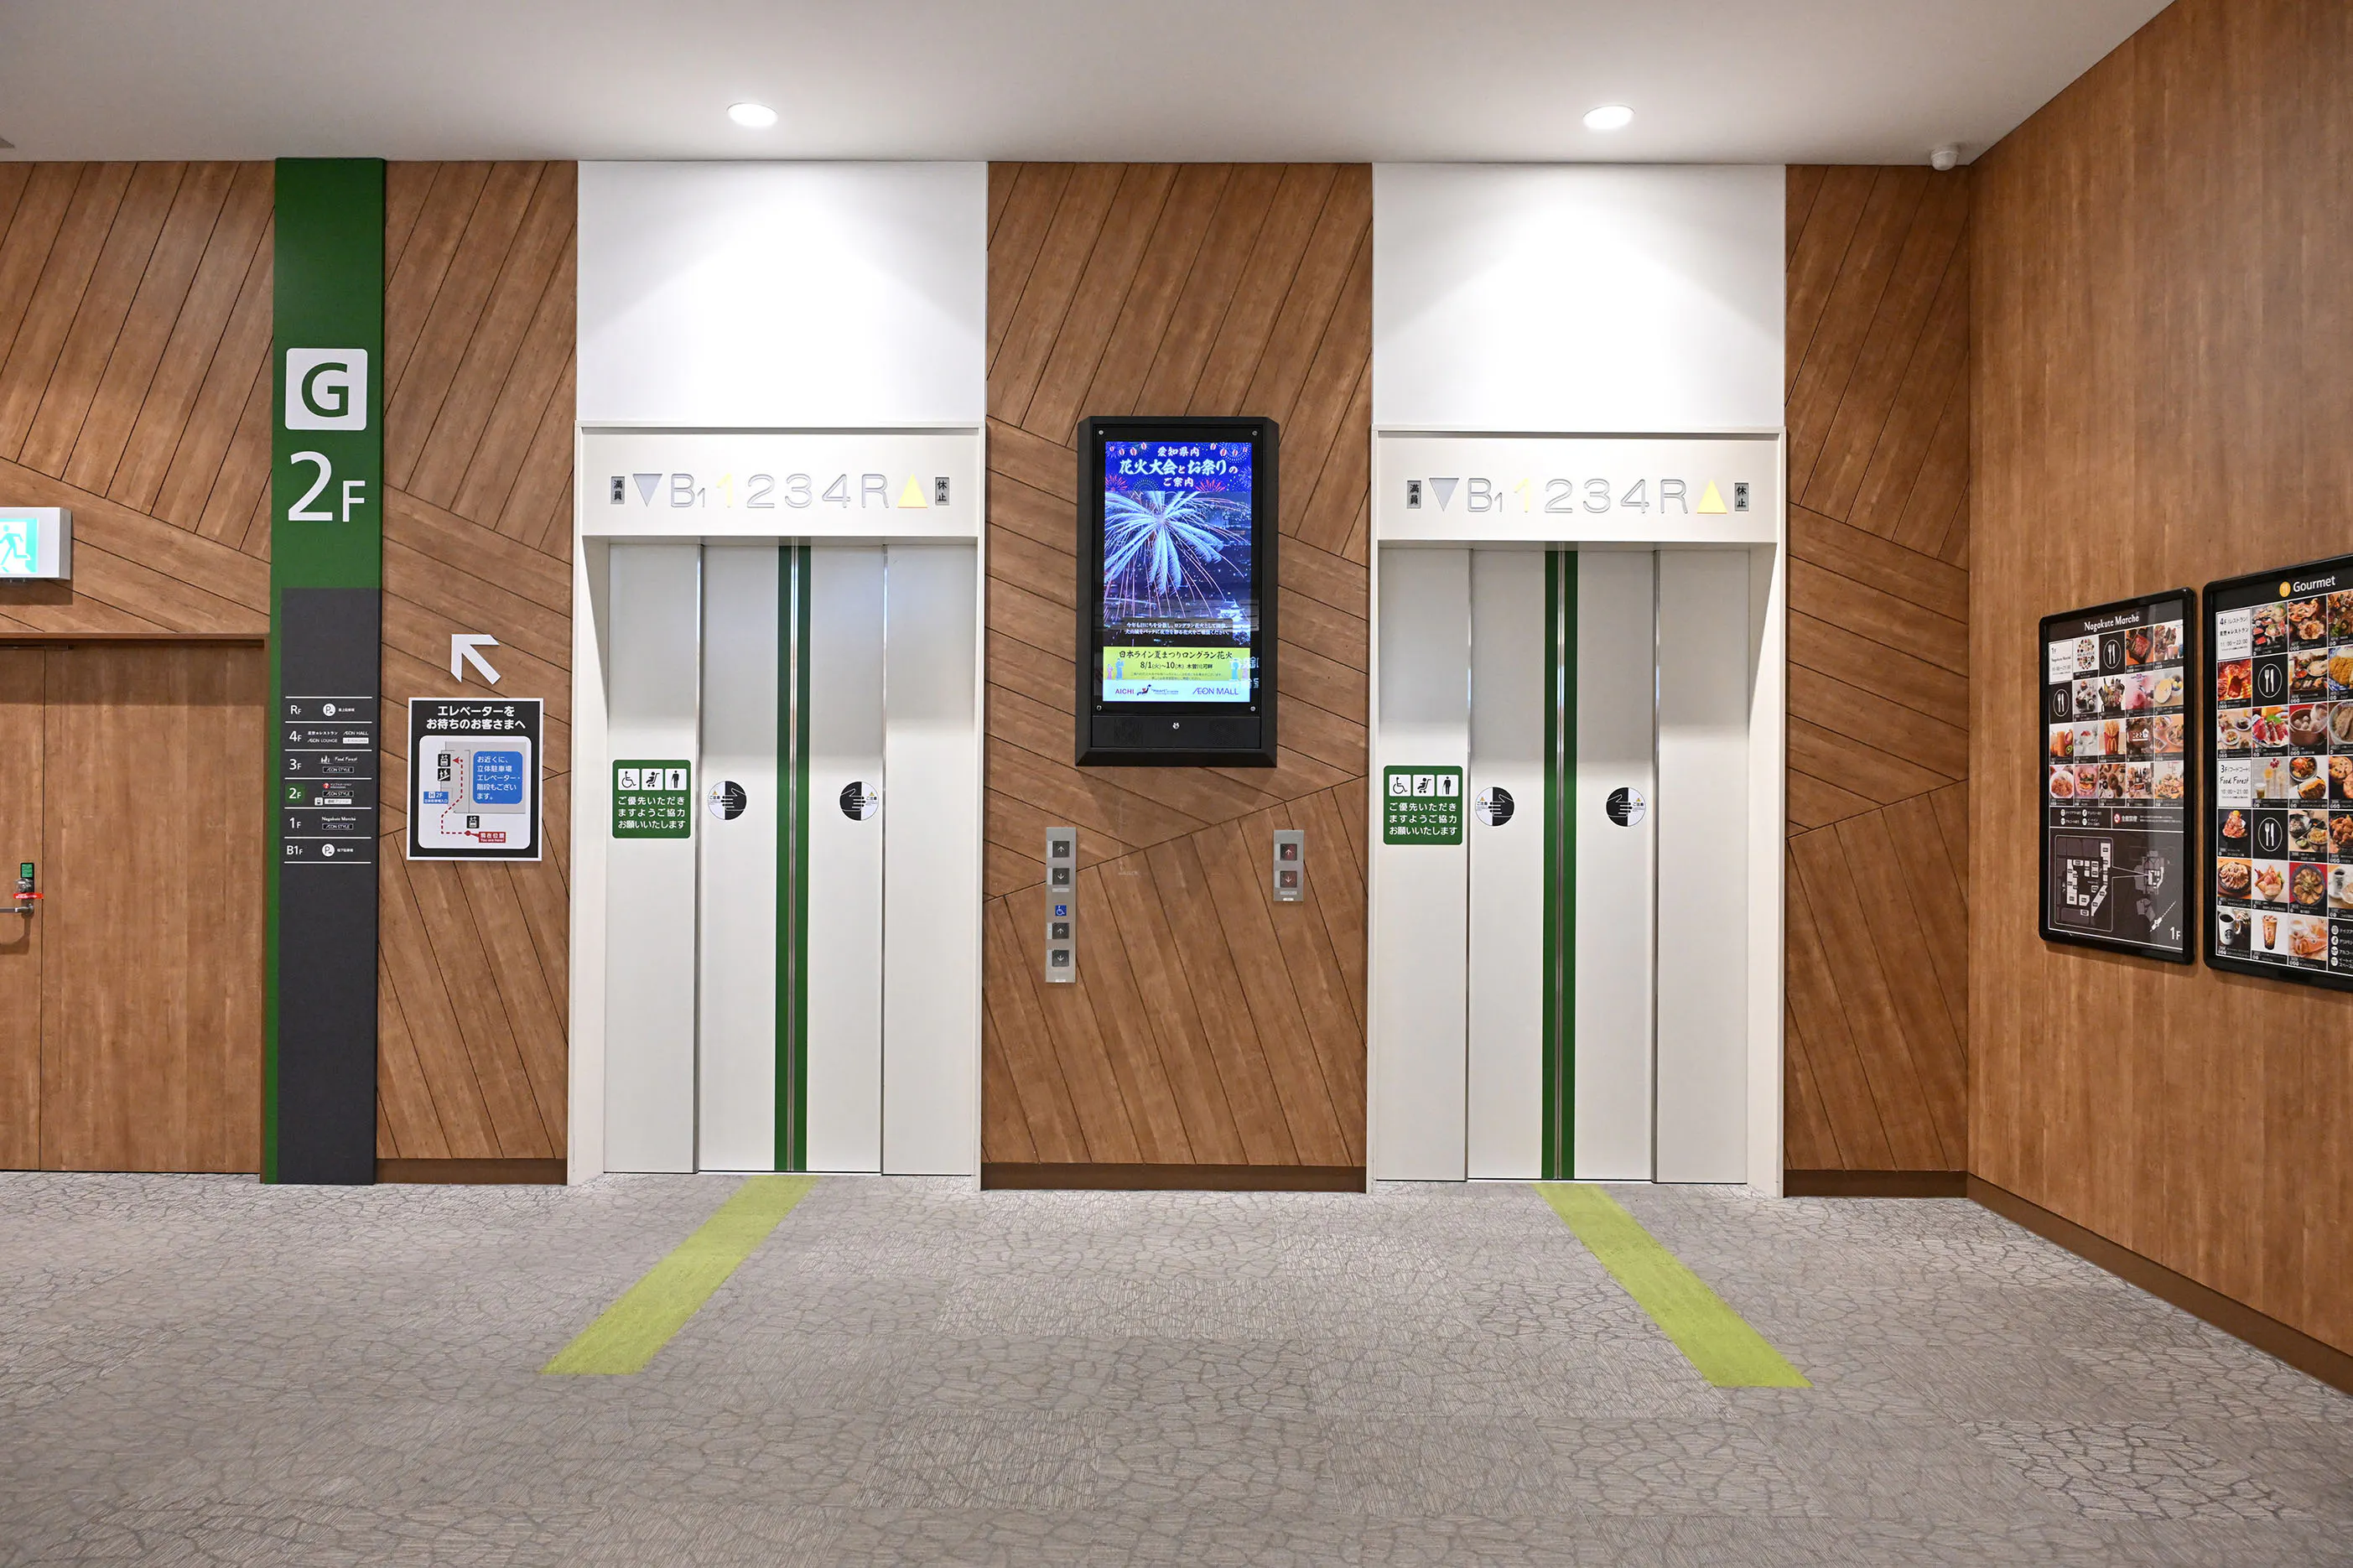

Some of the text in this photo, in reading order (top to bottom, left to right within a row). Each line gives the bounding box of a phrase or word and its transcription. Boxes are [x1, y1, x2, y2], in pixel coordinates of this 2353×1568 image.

[301, 362, 349, 418] G
[1157, 446, 1199, 457] 愛知県内
[1119, 459, 1238, 475] 花火大会とお祭りの
[288, 451, 366, 522] 2F
[1163, 477, 1194, 487] ご案内
[614, 480, 623, 501] 満員
[746, 473, 775, 508] 2
[785, 473, 812, 508] 3
[822, 473, 850, 508] 4
[861, 473, 890, 508] R
[937, 480, 948, 502] 休止
[1410, 484, 1420, 505] 満員
[1545, 478, 1573, 513] 2
[1583, 478, 1611, 513] 3
[1621, 479, 1649, 514] 4
[1660, 479, 1688, 514] R
[1737, 486, 1747, 508] 休止
[2293, 575, 2335, 593] Gourmet
[2084, 619, 2113, 632] Nagakute
[1119, 651, 1233, 659] 日本ライン夏まつりロングラン花火
[438, 706, 515, 717] エレベーターを
[427, 719, 526, 729] お待ちのお客さまへ
[289, 730, 302, 742] 4F
[289, 759, 302, 770] 3F
[2220, 776, 2231, 785] Food
[288, 787, 302, 799] 2F
[618, 797, 685, 805] ご優先いただき
[1389, 802, 1457, 811] ご優先いただき
[618, 808, 685, 818] ますようご協力
[1389, 814, 1457, 823] ますようご協力
[289, 818, 301, 828] 1F
[618, 820, 686, 829] お願いいたします
[1389, 826, 1457, 835] お願いいたします
[287, 845, 303, 855] B1F
[2170, 927, 2181, 940] 1F
